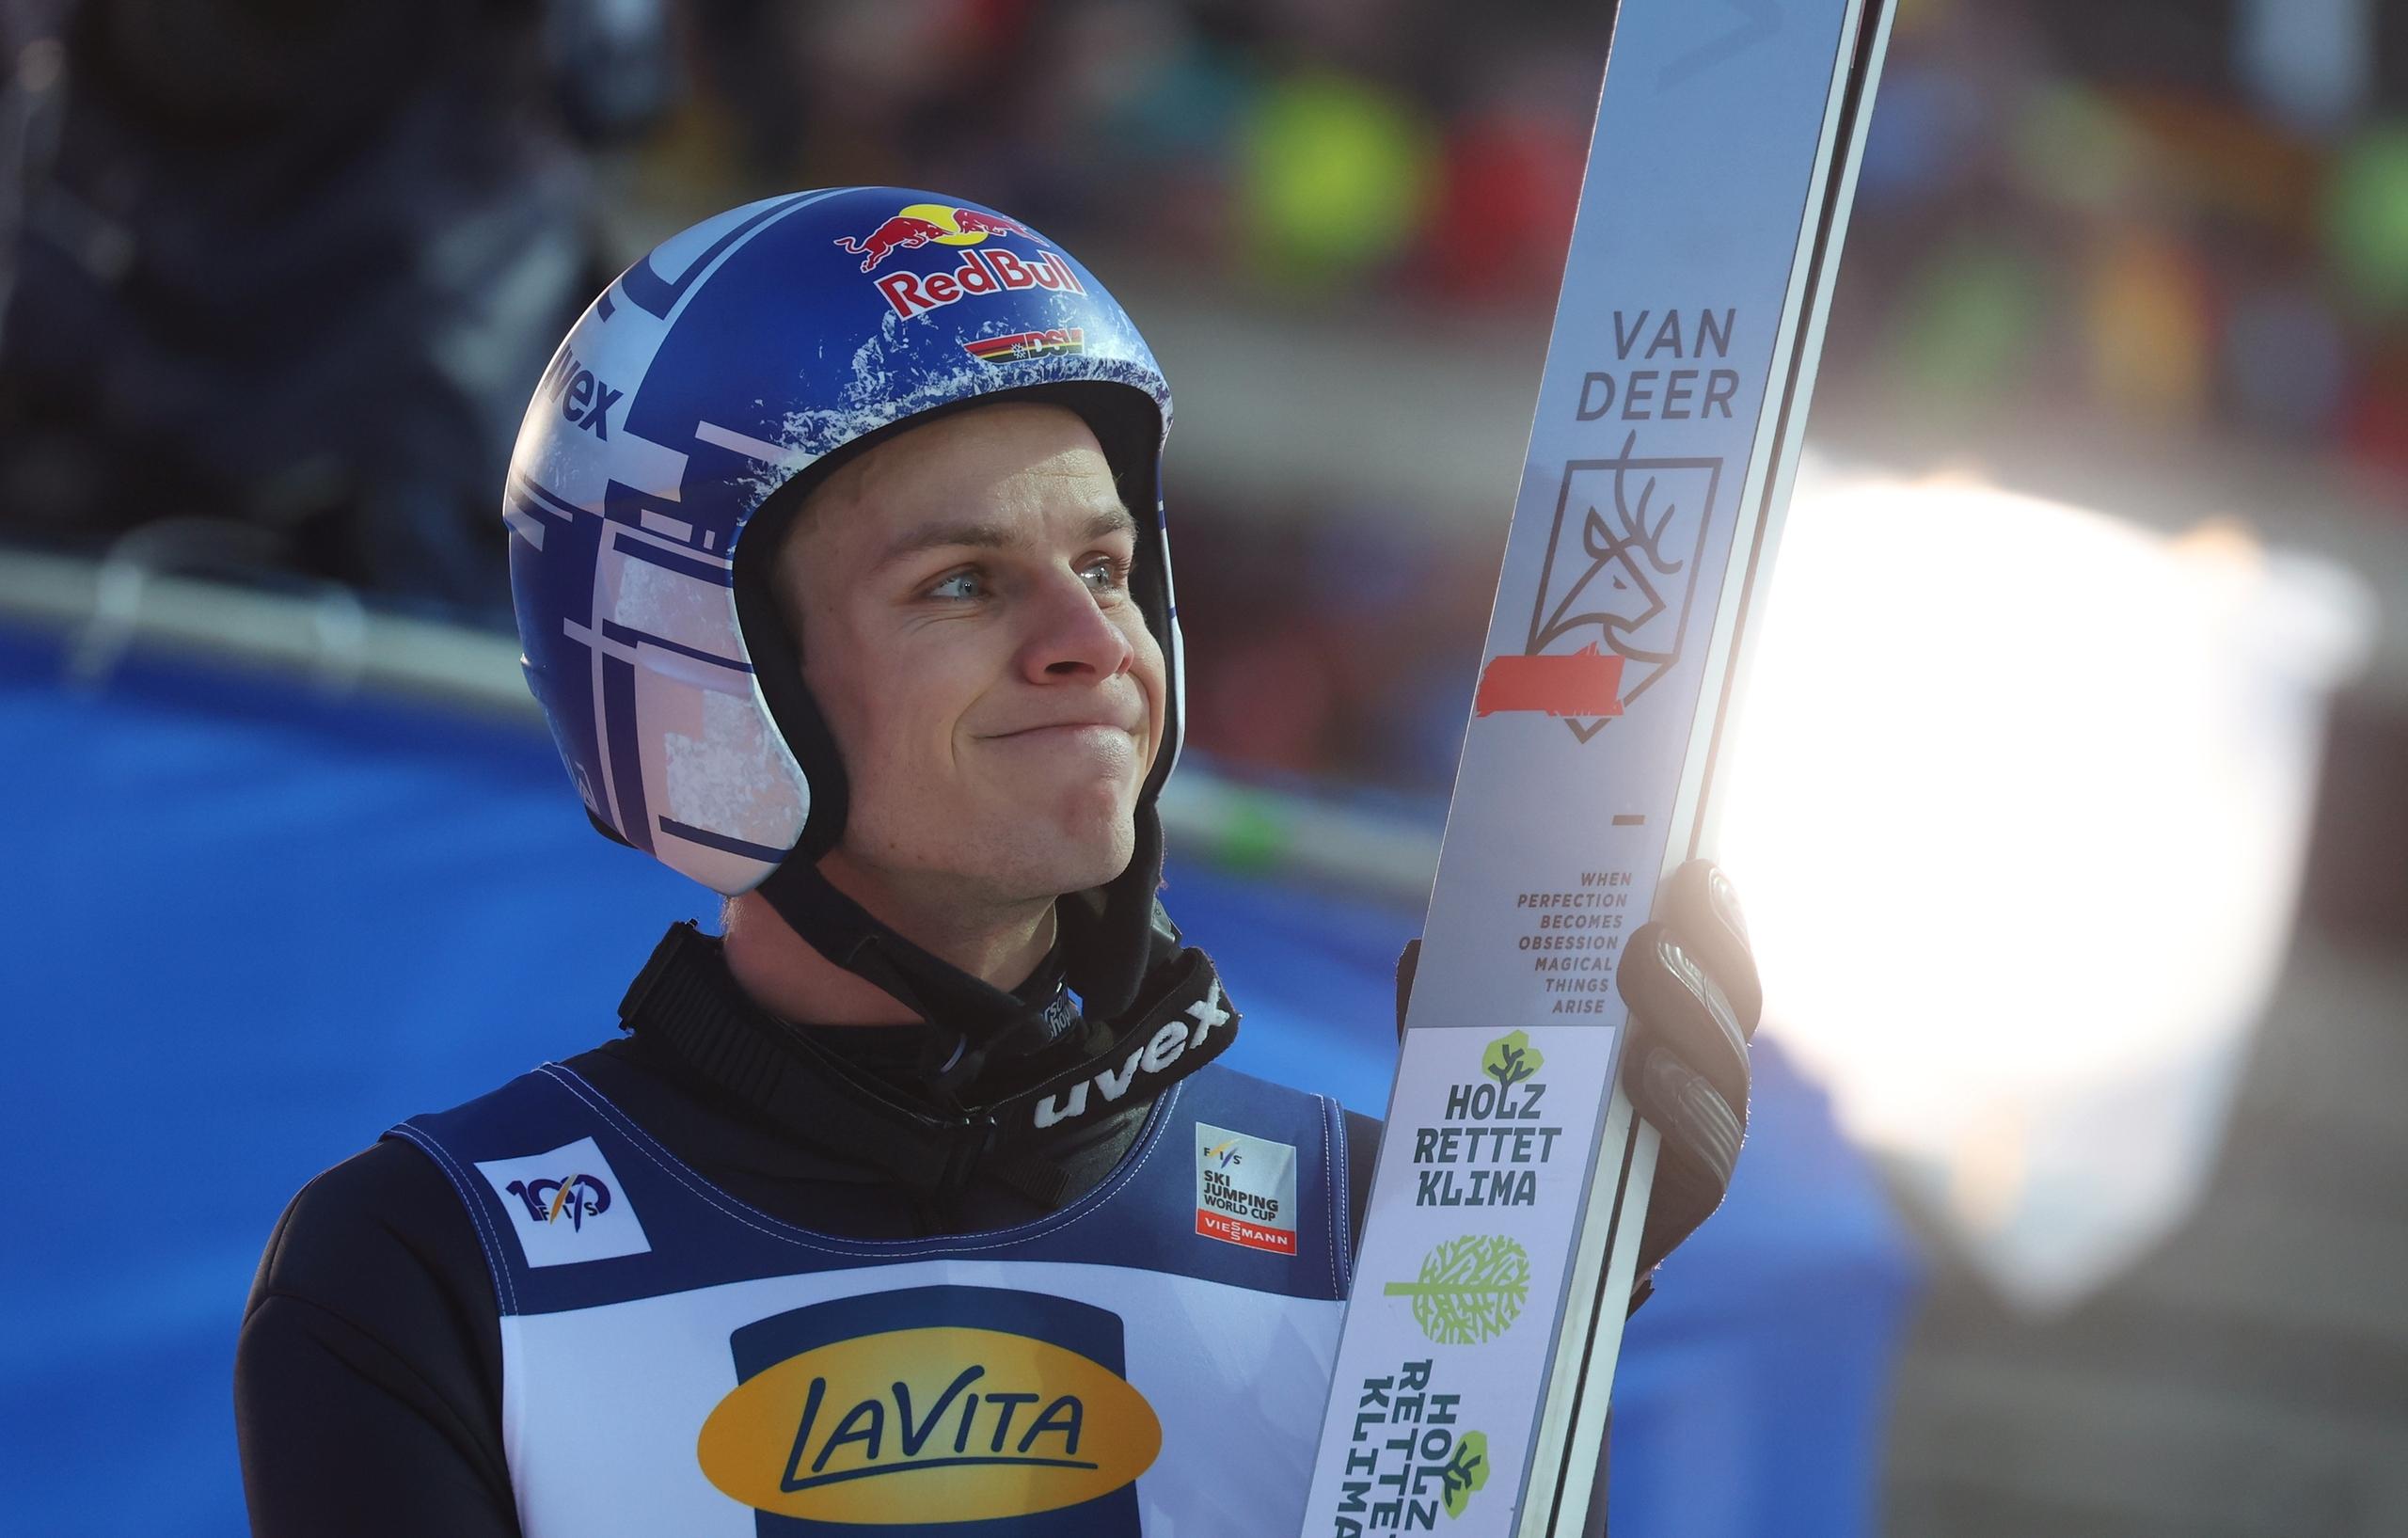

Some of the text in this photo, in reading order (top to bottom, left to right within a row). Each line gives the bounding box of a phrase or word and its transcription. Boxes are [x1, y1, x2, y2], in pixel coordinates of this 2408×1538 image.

[875, 249, 1086, 321] Red Bull
[1613, 308, 1736, 360] VAN
[1576, 369, 1739, 421] DEER
[1581, 872, 1632, 886] WHEN
[1517, 894, 1627, 908] PERFECTION
[1540, 915, 1623, 928] BECOMES
[1519, 936, 1618, 950] OBSESSION
[1534, 957, 1612, 972] MAGICAL
[1545, 978, 1608, 992] THINGS
[1552, 1000, 1605, 1014] ARISE
[1034, 977, 1230, 1129] uvex
[1445, 1083, 1546, 1120] HOLZ
[1204, 1147, 1243, 1165] FIS
[1413, 1127, 1562, 1163] RETTET
[1204, 1169, 1230, 1187] SKI
[1416, 1170, 1537, 1206] KLIMA
[1204, 1182, 1278, 1212] JUMPING
[1204, 1195, 1276, 1221] WORLD CUP
[1205, 1217, 1288, 1245] VIESSMANN
[1370, 1358, 1434, 1538] RETTE
[1404, 1394, 1461, 1530] HOLZ
